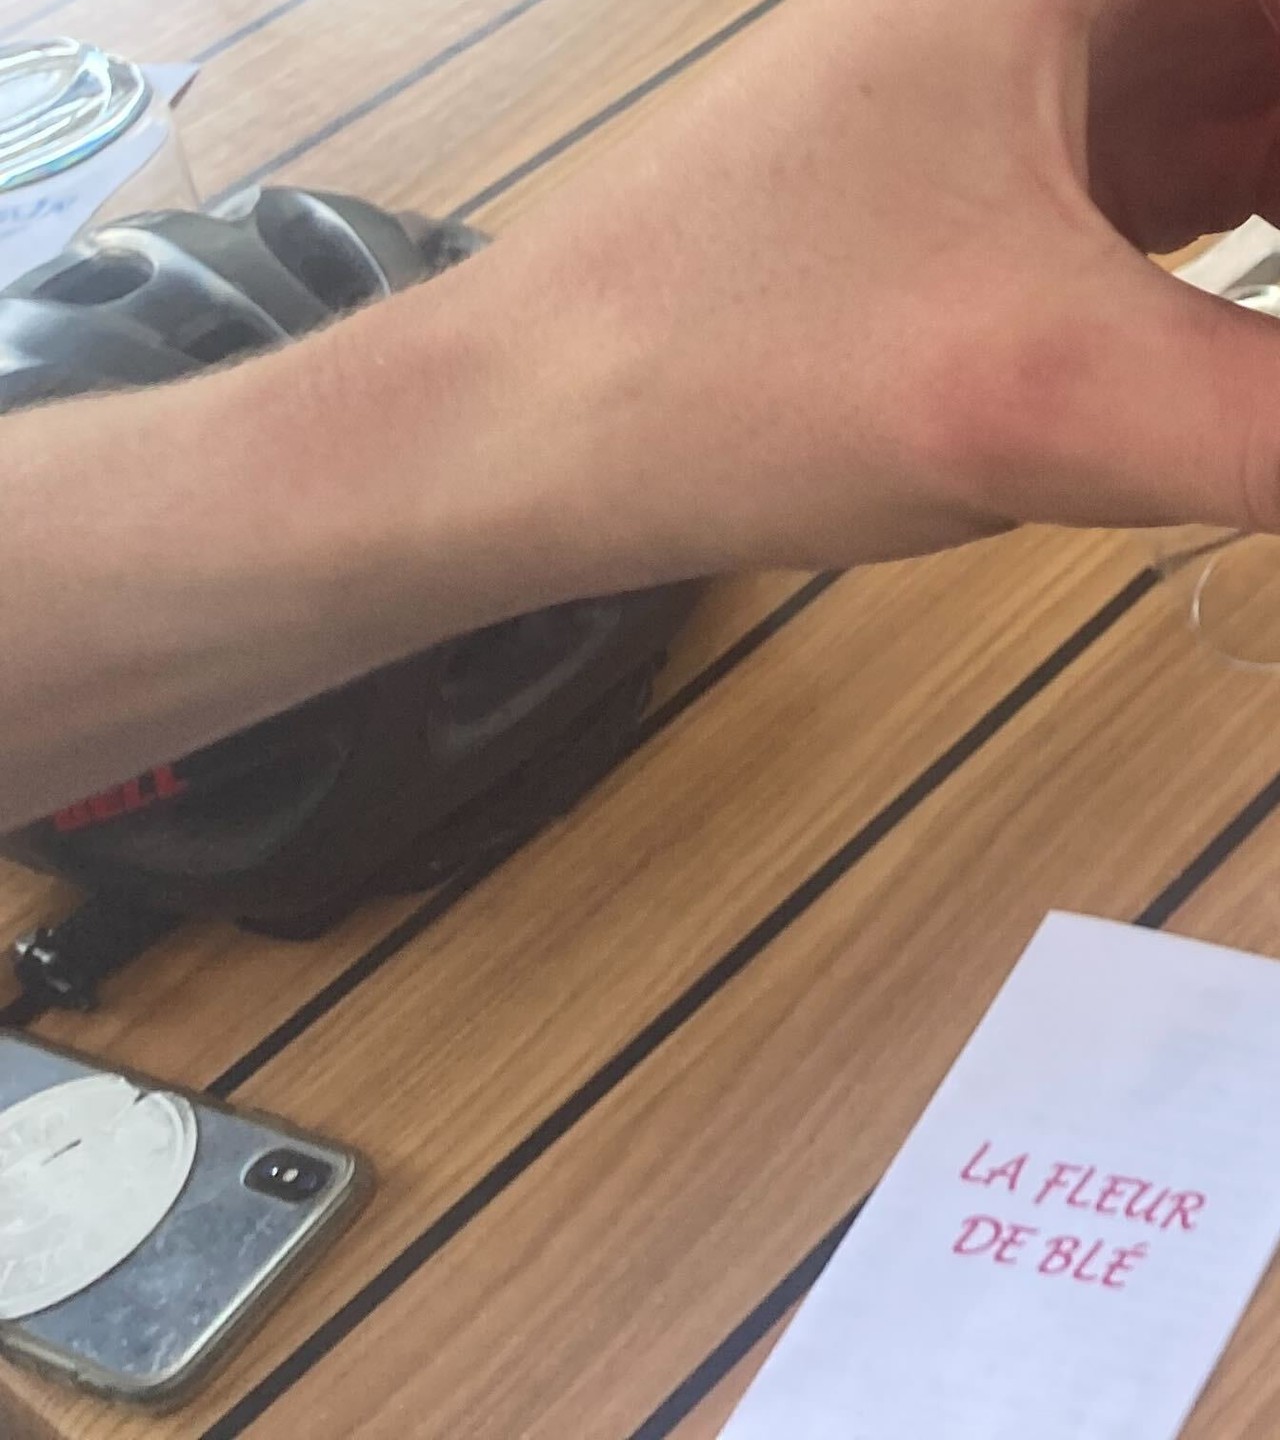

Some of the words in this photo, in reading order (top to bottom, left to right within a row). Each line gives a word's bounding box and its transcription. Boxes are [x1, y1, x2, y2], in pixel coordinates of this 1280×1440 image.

[960, 1139, 1030, 1193] LA
[1033, 1161, 1206, 1232] FLEUR
[952, 1214, 1039, 1264] DE
[1037, 1234, 1149, 1288] BLÉ
